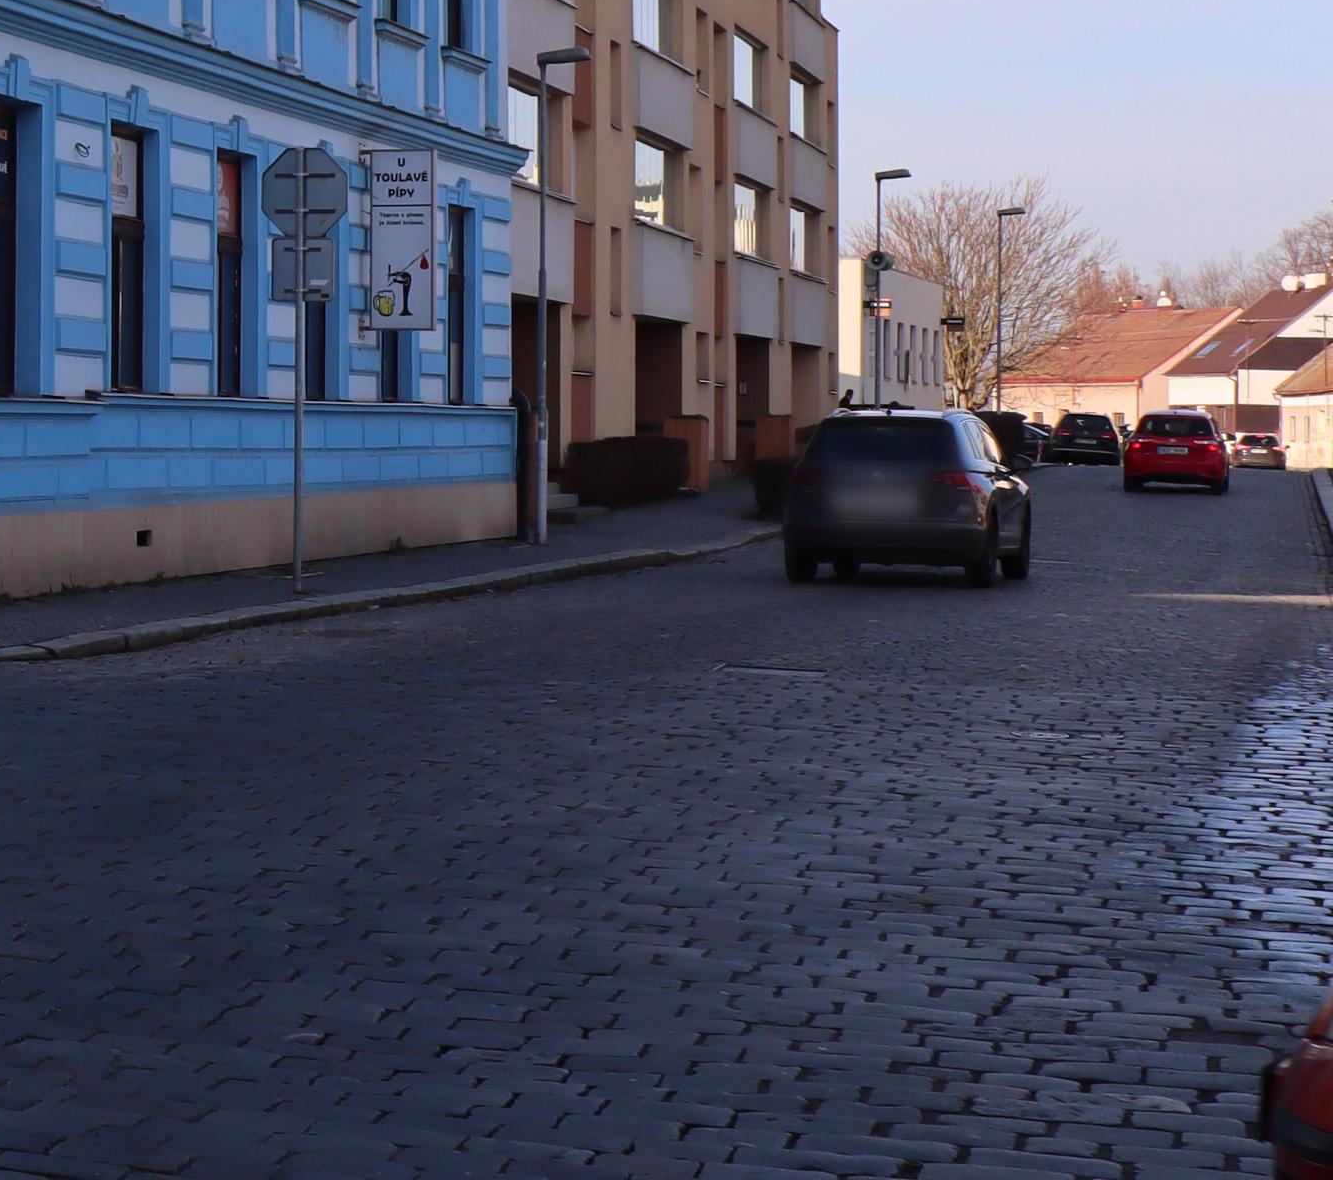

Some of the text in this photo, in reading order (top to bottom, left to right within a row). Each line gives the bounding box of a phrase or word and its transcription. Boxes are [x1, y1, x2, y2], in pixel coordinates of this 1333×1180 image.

[397, 158, 406, 167] U
[374, 171, 429, 182] TOULAVÉ
[388, 186, 415, 198] PÍPY
